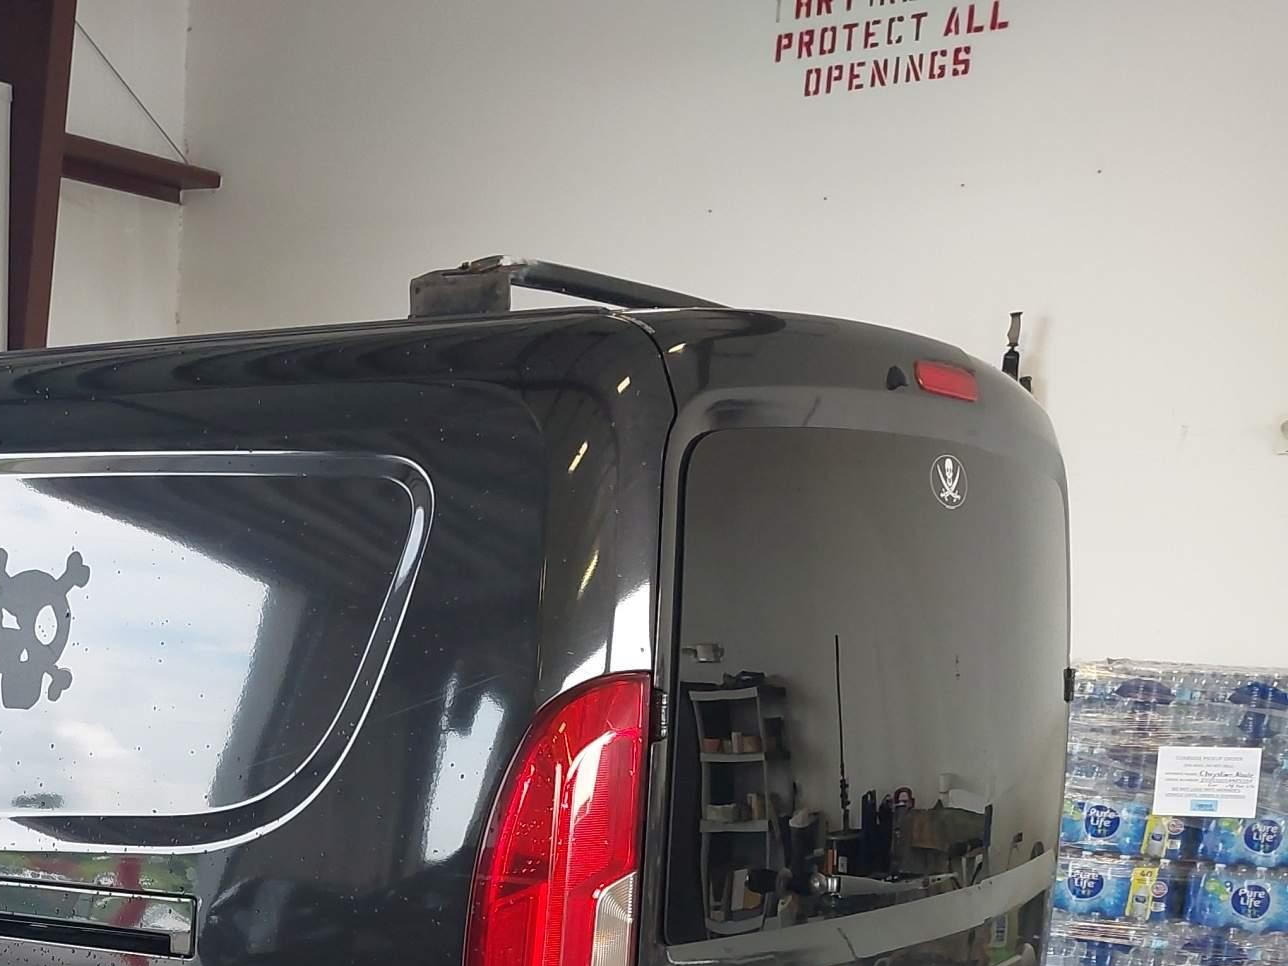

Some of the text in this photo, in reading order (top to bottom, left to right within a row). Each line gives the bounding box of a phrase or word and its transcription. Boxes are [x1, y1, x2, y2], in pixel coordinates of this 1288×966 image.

[775, 12, 928, 63] PROTECT
[943, 0, 1009, 37] ALL
[804, 46, 972, 97] OPENINGS
[1089, 807, 1116, 819] Pure
[1090, 817, 1112, 829] Life
[1252, 823, 1279, 835] Pure
[1252, 832, 1275, 844] Life
[1074, 879, 1095, 890] Life
[1239, 888, 1266, 900] Pure
[1239, 897, 1261, 909] Life
